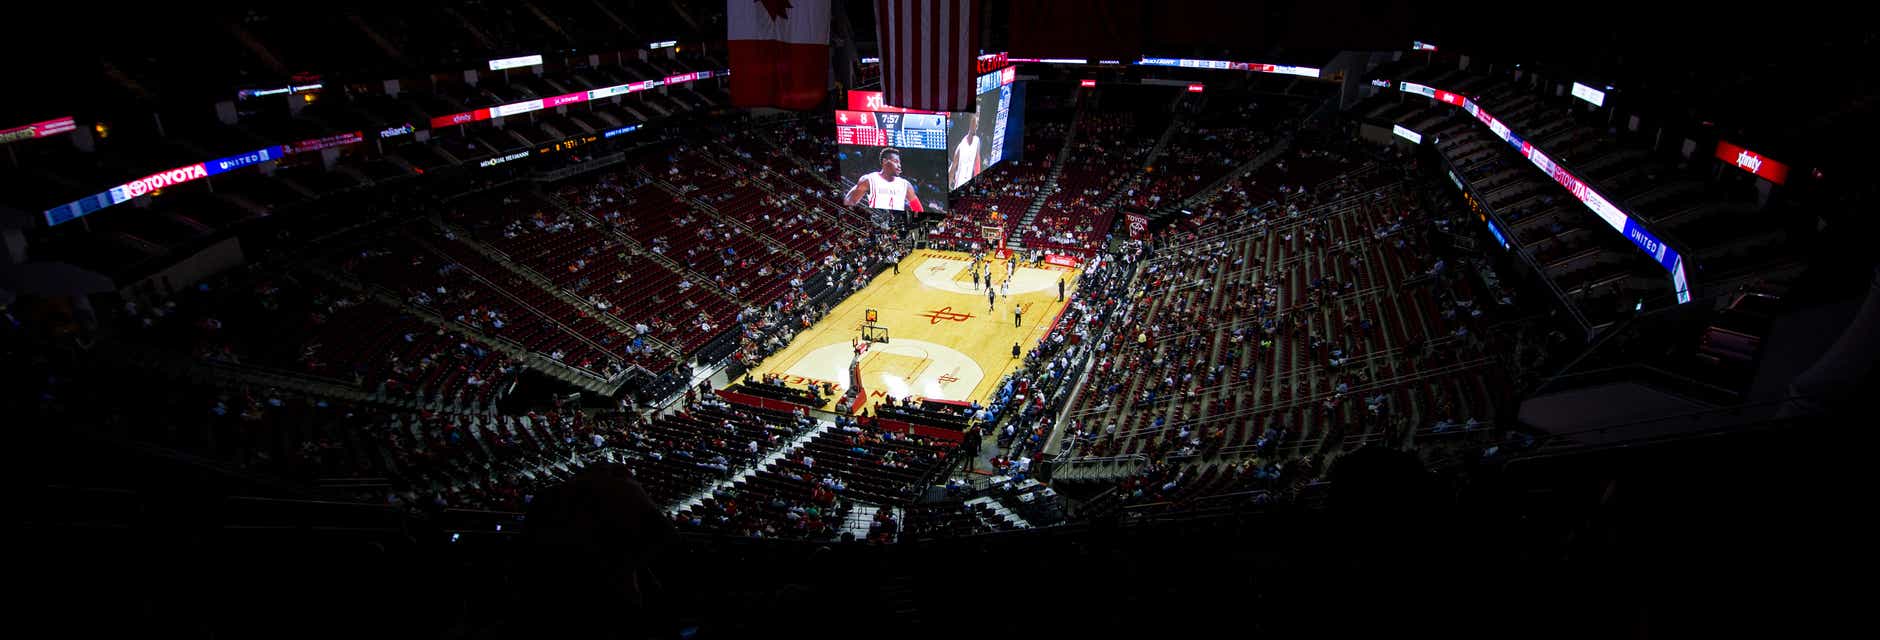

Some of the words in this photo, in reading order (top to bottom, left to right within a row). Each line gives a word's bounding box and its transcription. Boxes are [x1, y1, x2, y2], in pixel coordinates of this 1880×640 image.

[860, 113, 868, 124] 8
[881, 114, 900, 124] 7:57
[380, 125, 408, 138] reliant
[219, 154, 258, 169] UNITED
[1736, 150, 1762, 174] xfinity
[144, 164, 208, 191] TOYOTA
[1559, 174, 1585, 201] TOYOTA
[1631, 228, 1657, 253] UNITED
